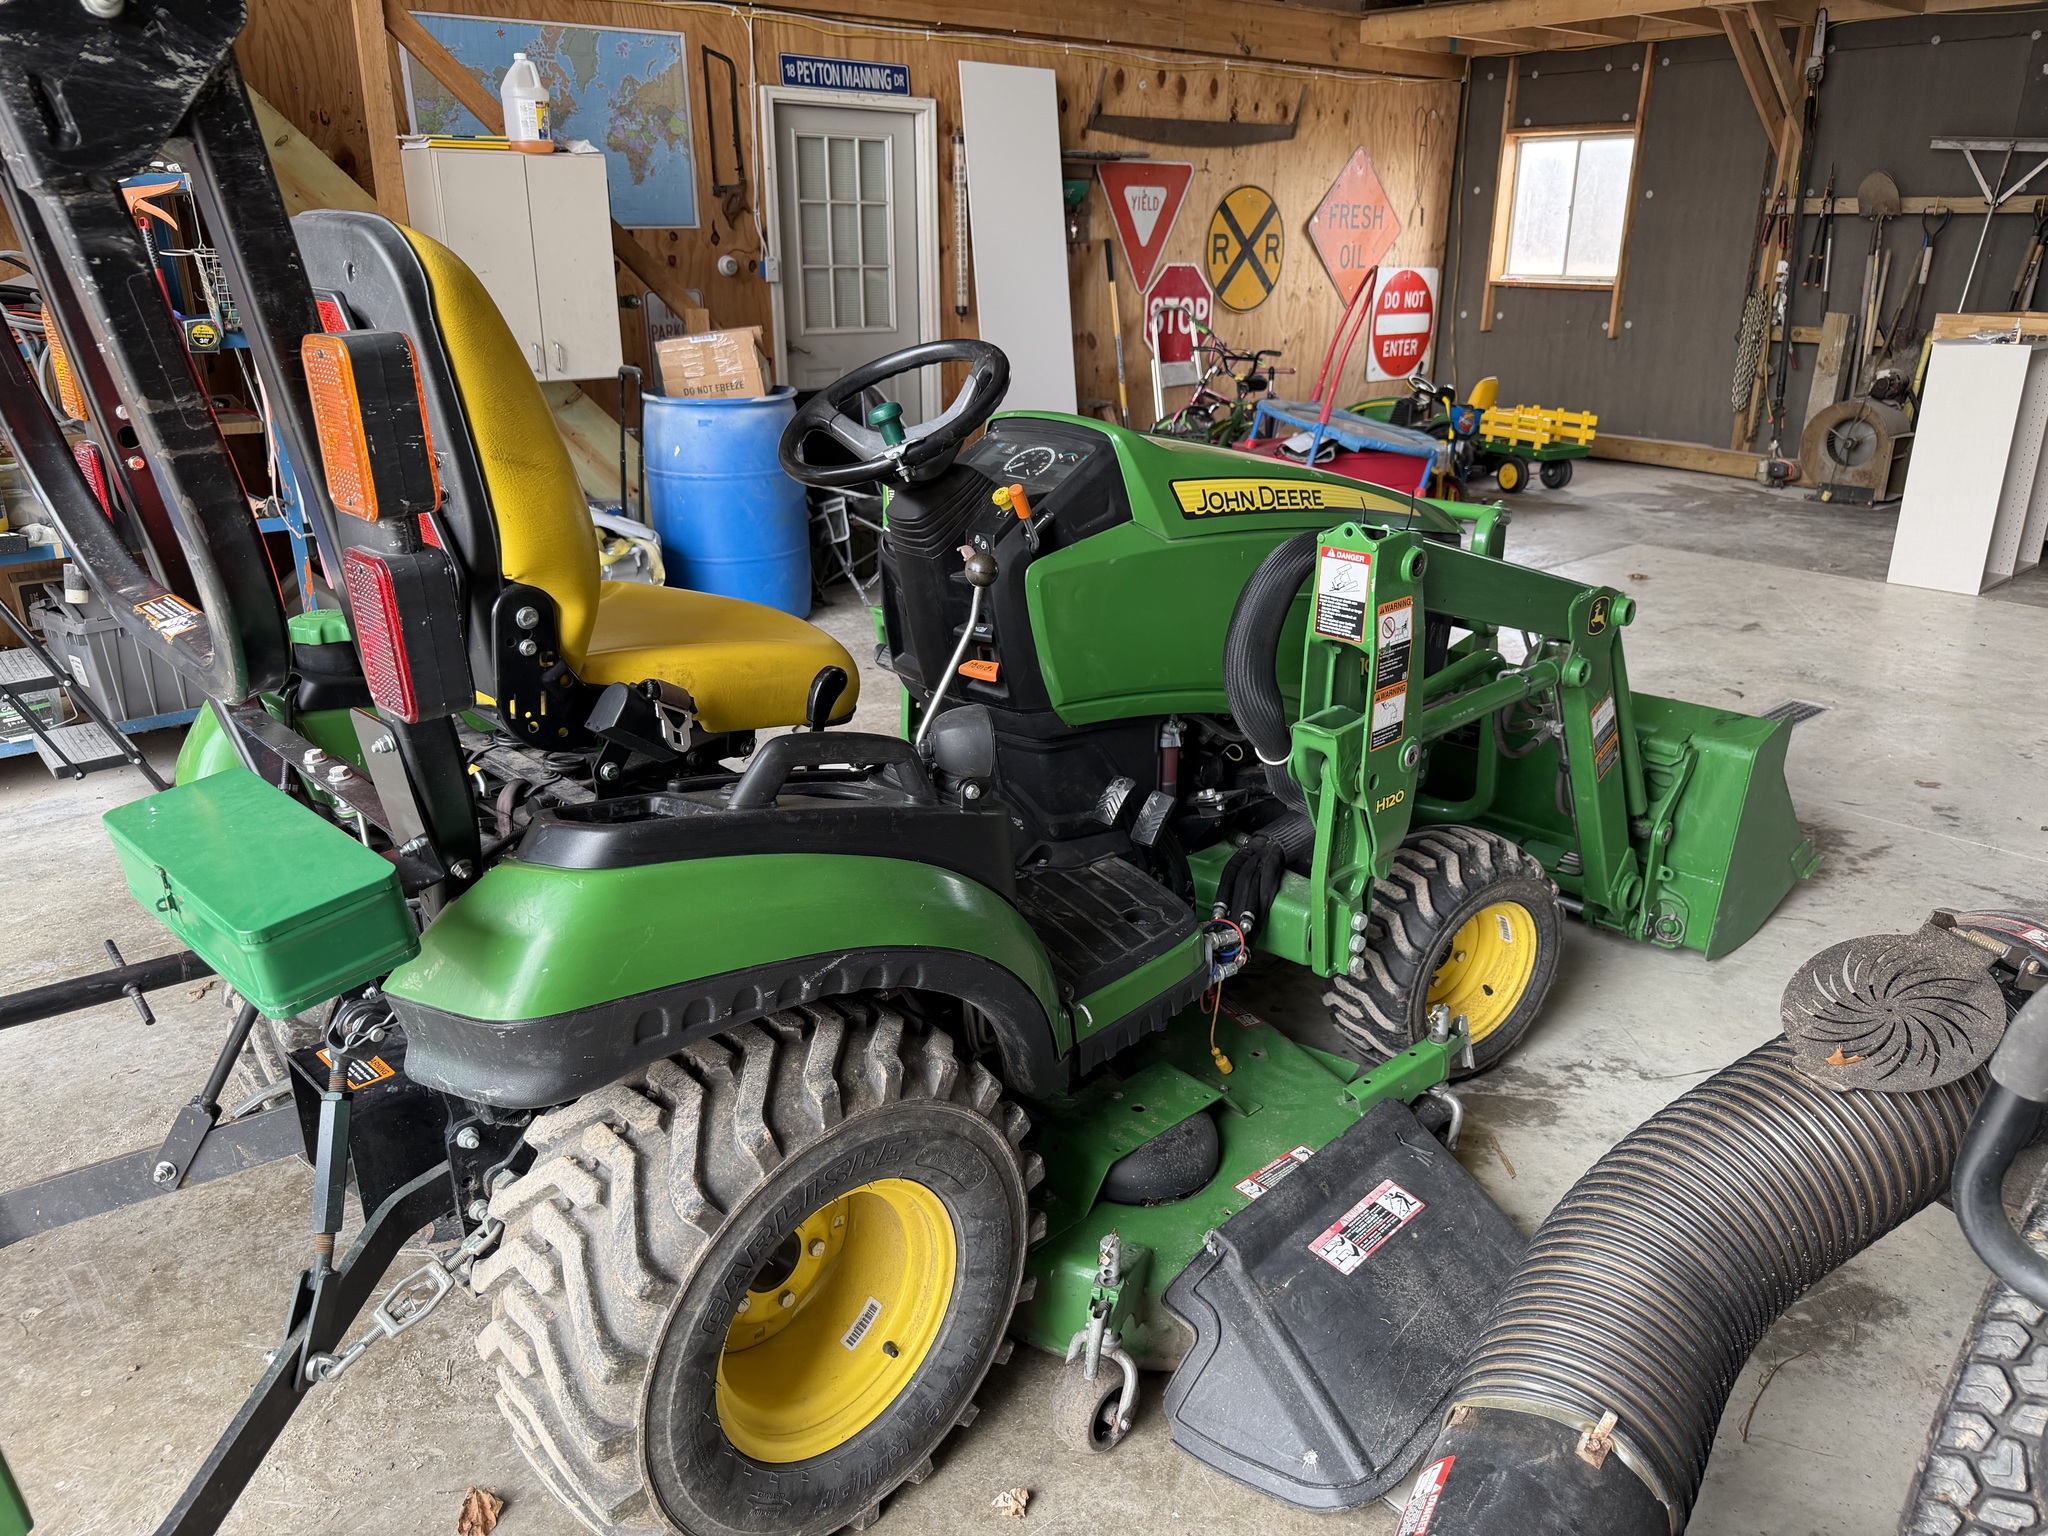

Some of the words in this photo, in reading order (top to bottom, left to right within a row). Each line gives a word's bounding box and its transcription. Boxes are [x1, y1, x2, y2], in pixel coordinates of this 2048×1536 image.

[785, 63, 796, 78] 18
[796, 60, 841, 86] PEYTON
[841, 65, 892, 90] MANNING
[893, 73, 905, 87] DR
[1131, 195, 1160, 211] YIELD
[1328, 203, 1385, 230] FRESH
[1212, 233, 1230, 265] R
[1264, 233, 1280, 264] R
[1339, 244, 1366, 270] OIL
[1384, 291, 1400, 309] DO
[1403, 290, 1426, 308] NOT
[1150, 297, 1209, 334] STOP
[651, 324, 686, 340] PARKI
[1382, 338, 1418, 358] ENTER
[683, 387, 695, 397] DO
[697, 384, 713, 395] NOT
[715, 381, 745, 393] FREEZE
[1195, 488, 1256, 512] JOHN
[1258, 485, 1325, 508] DEERE
[1336, 551, 1365, 563] DANGER
[1384, 597, 1411, 613] WARNING
[1380, 684, 1406, 699] WARNING
[1375, 789, 1405, 814] H120
[370, 1058, 390, 1075] ARNING
[1345, 1202, 1369, 1225] DANGER
[701, 1137, 910, 1335] CARLISLE
[925, 1335, 987, 1426] TRAC
[1414, 1493, 1439, 1535] DANGER
